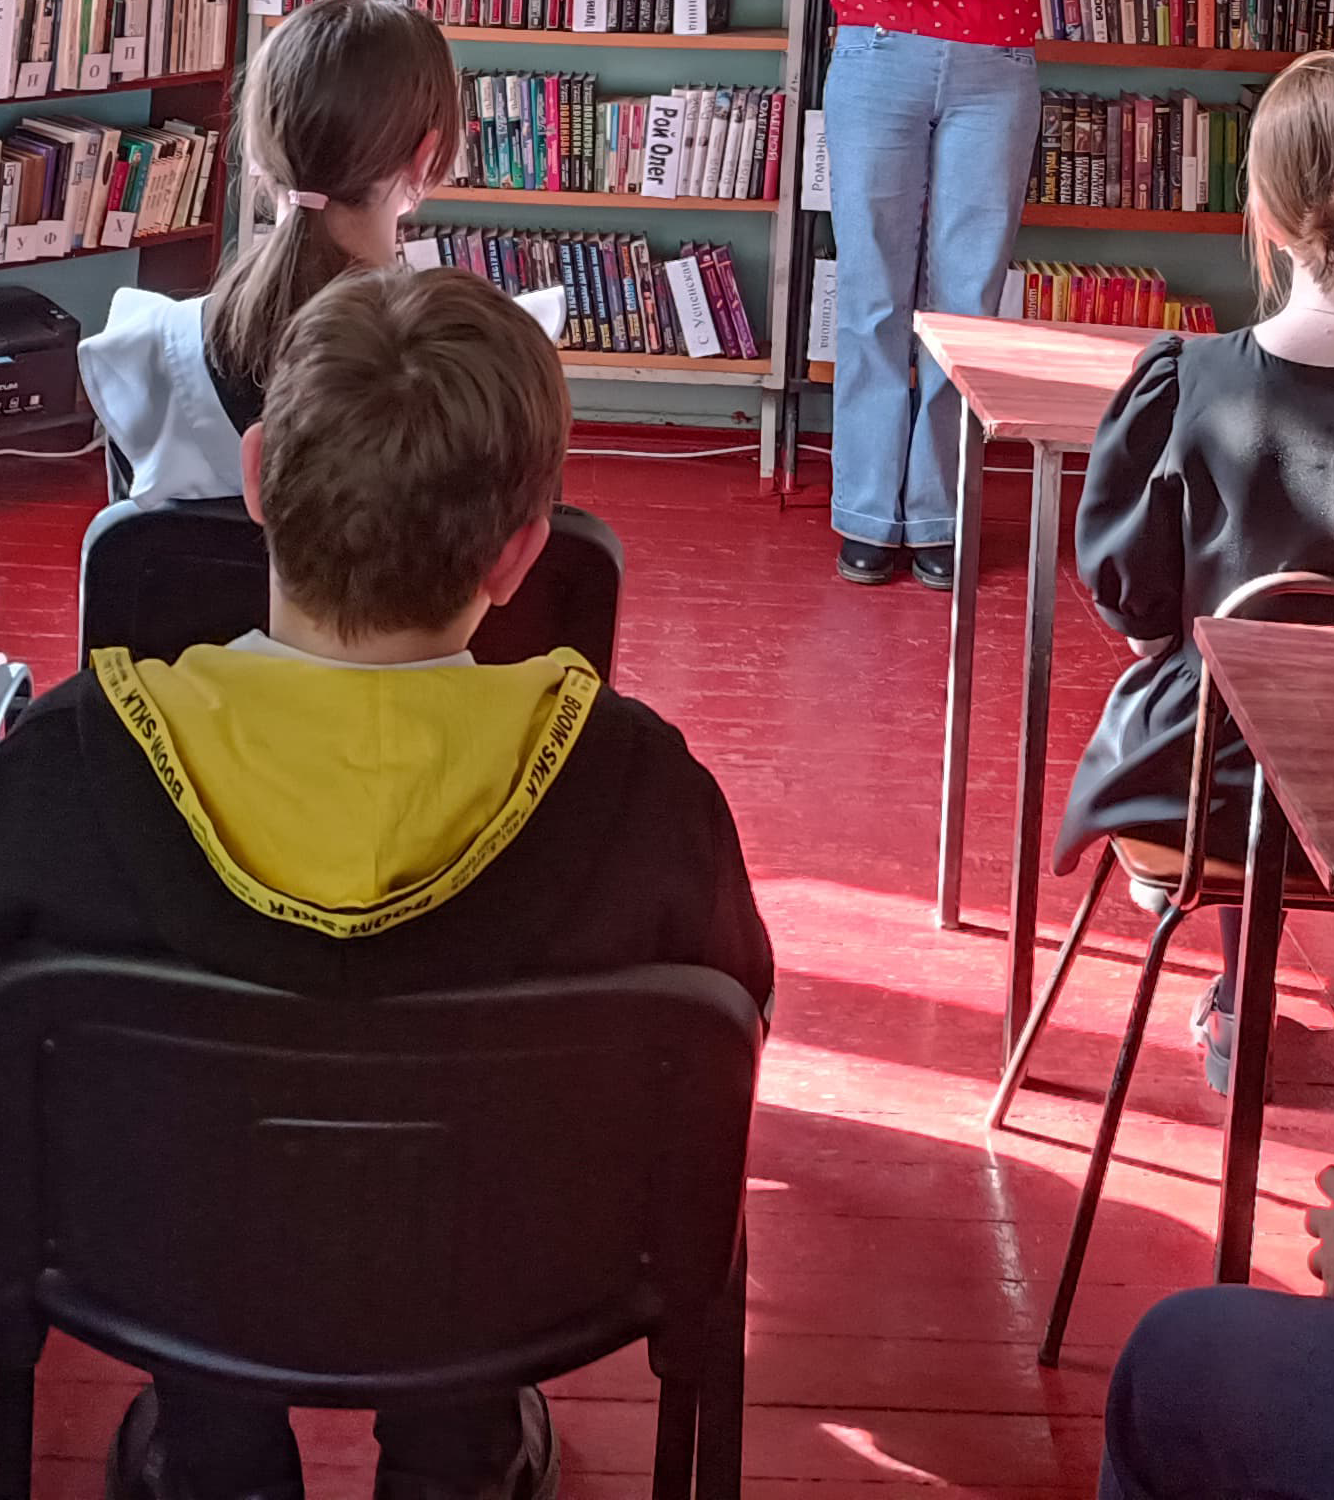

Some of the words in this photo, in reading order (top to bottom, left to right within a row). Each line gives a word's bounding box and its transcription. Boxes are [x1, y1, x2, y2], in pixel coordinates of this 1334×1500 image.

[124, 46, 137, 61] П
[654, 107, 677, 136] Рой
[650, 143, 672, 185] Олег
[811, 132, 827, 192] Романы
[43, 231, 58, 246] Ф
[112, 217, 126, 234] Х
[680, 261, 706, 328] Успенская
